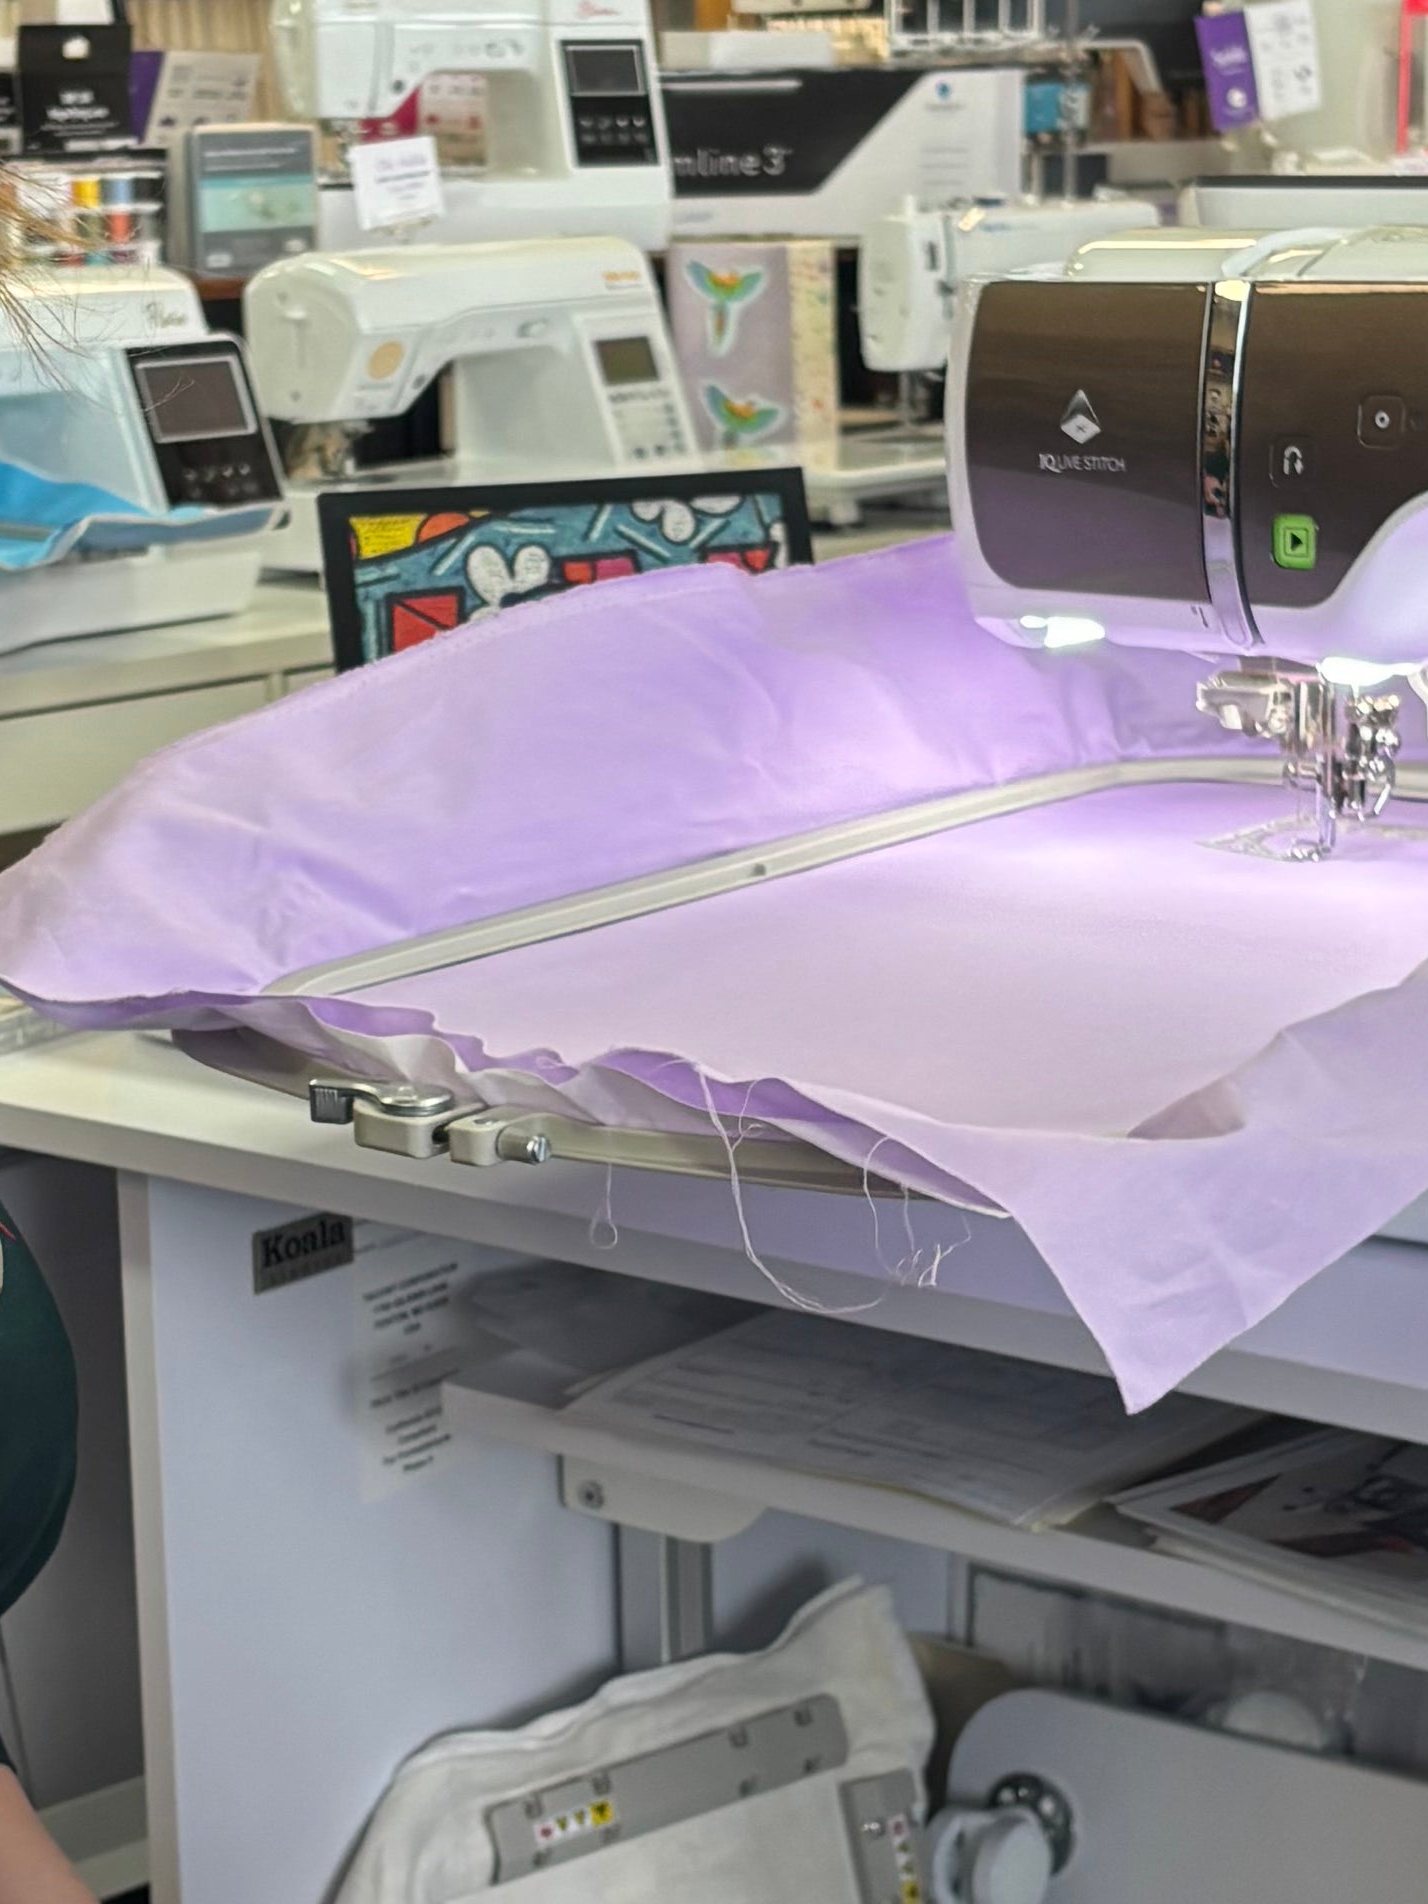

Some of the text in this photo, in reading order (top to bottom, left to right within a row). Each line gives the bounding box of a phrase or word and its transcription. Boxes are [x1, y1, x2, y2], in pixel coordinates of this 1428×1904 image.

[1039, 453, 1062, 473] IQ
[1083, 456, 1126, 472] STITCH
[261, 1219, 346, 1268] Koala
